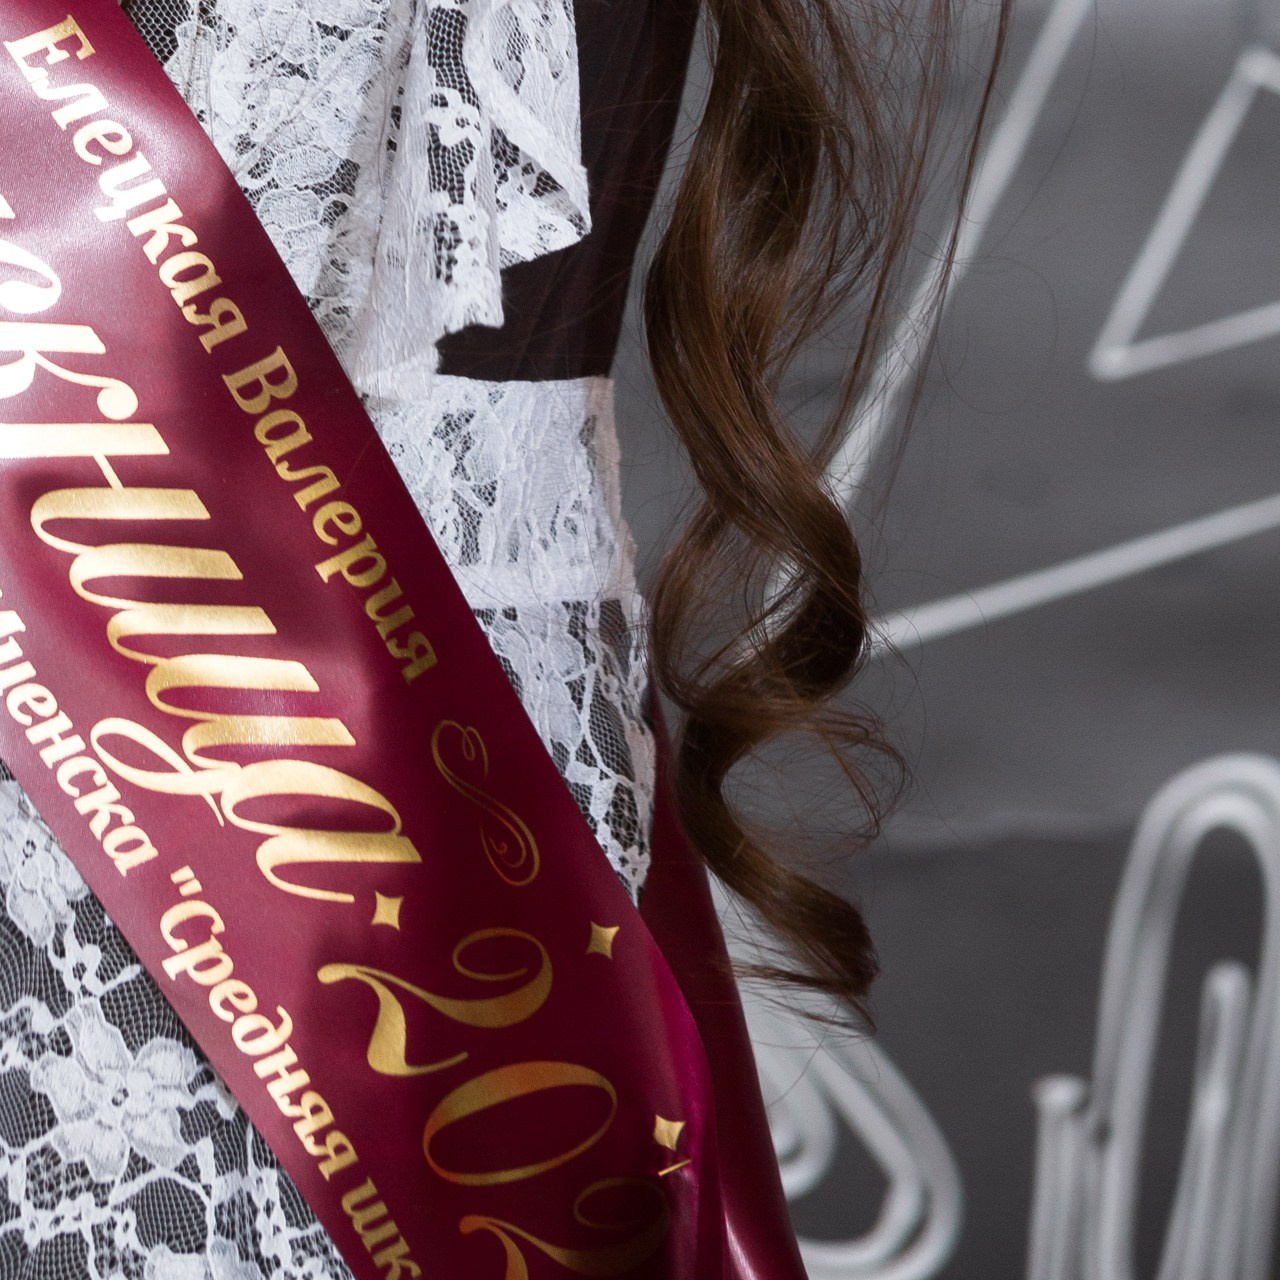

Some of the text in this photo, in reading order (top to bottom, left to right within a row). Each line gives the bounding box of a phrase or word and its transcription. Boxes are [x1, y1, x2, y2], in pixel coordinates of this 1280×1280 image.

[4, 14, 438, 687] Елецкая Валерия
[157, 864, 360, 1183] "Средняя
